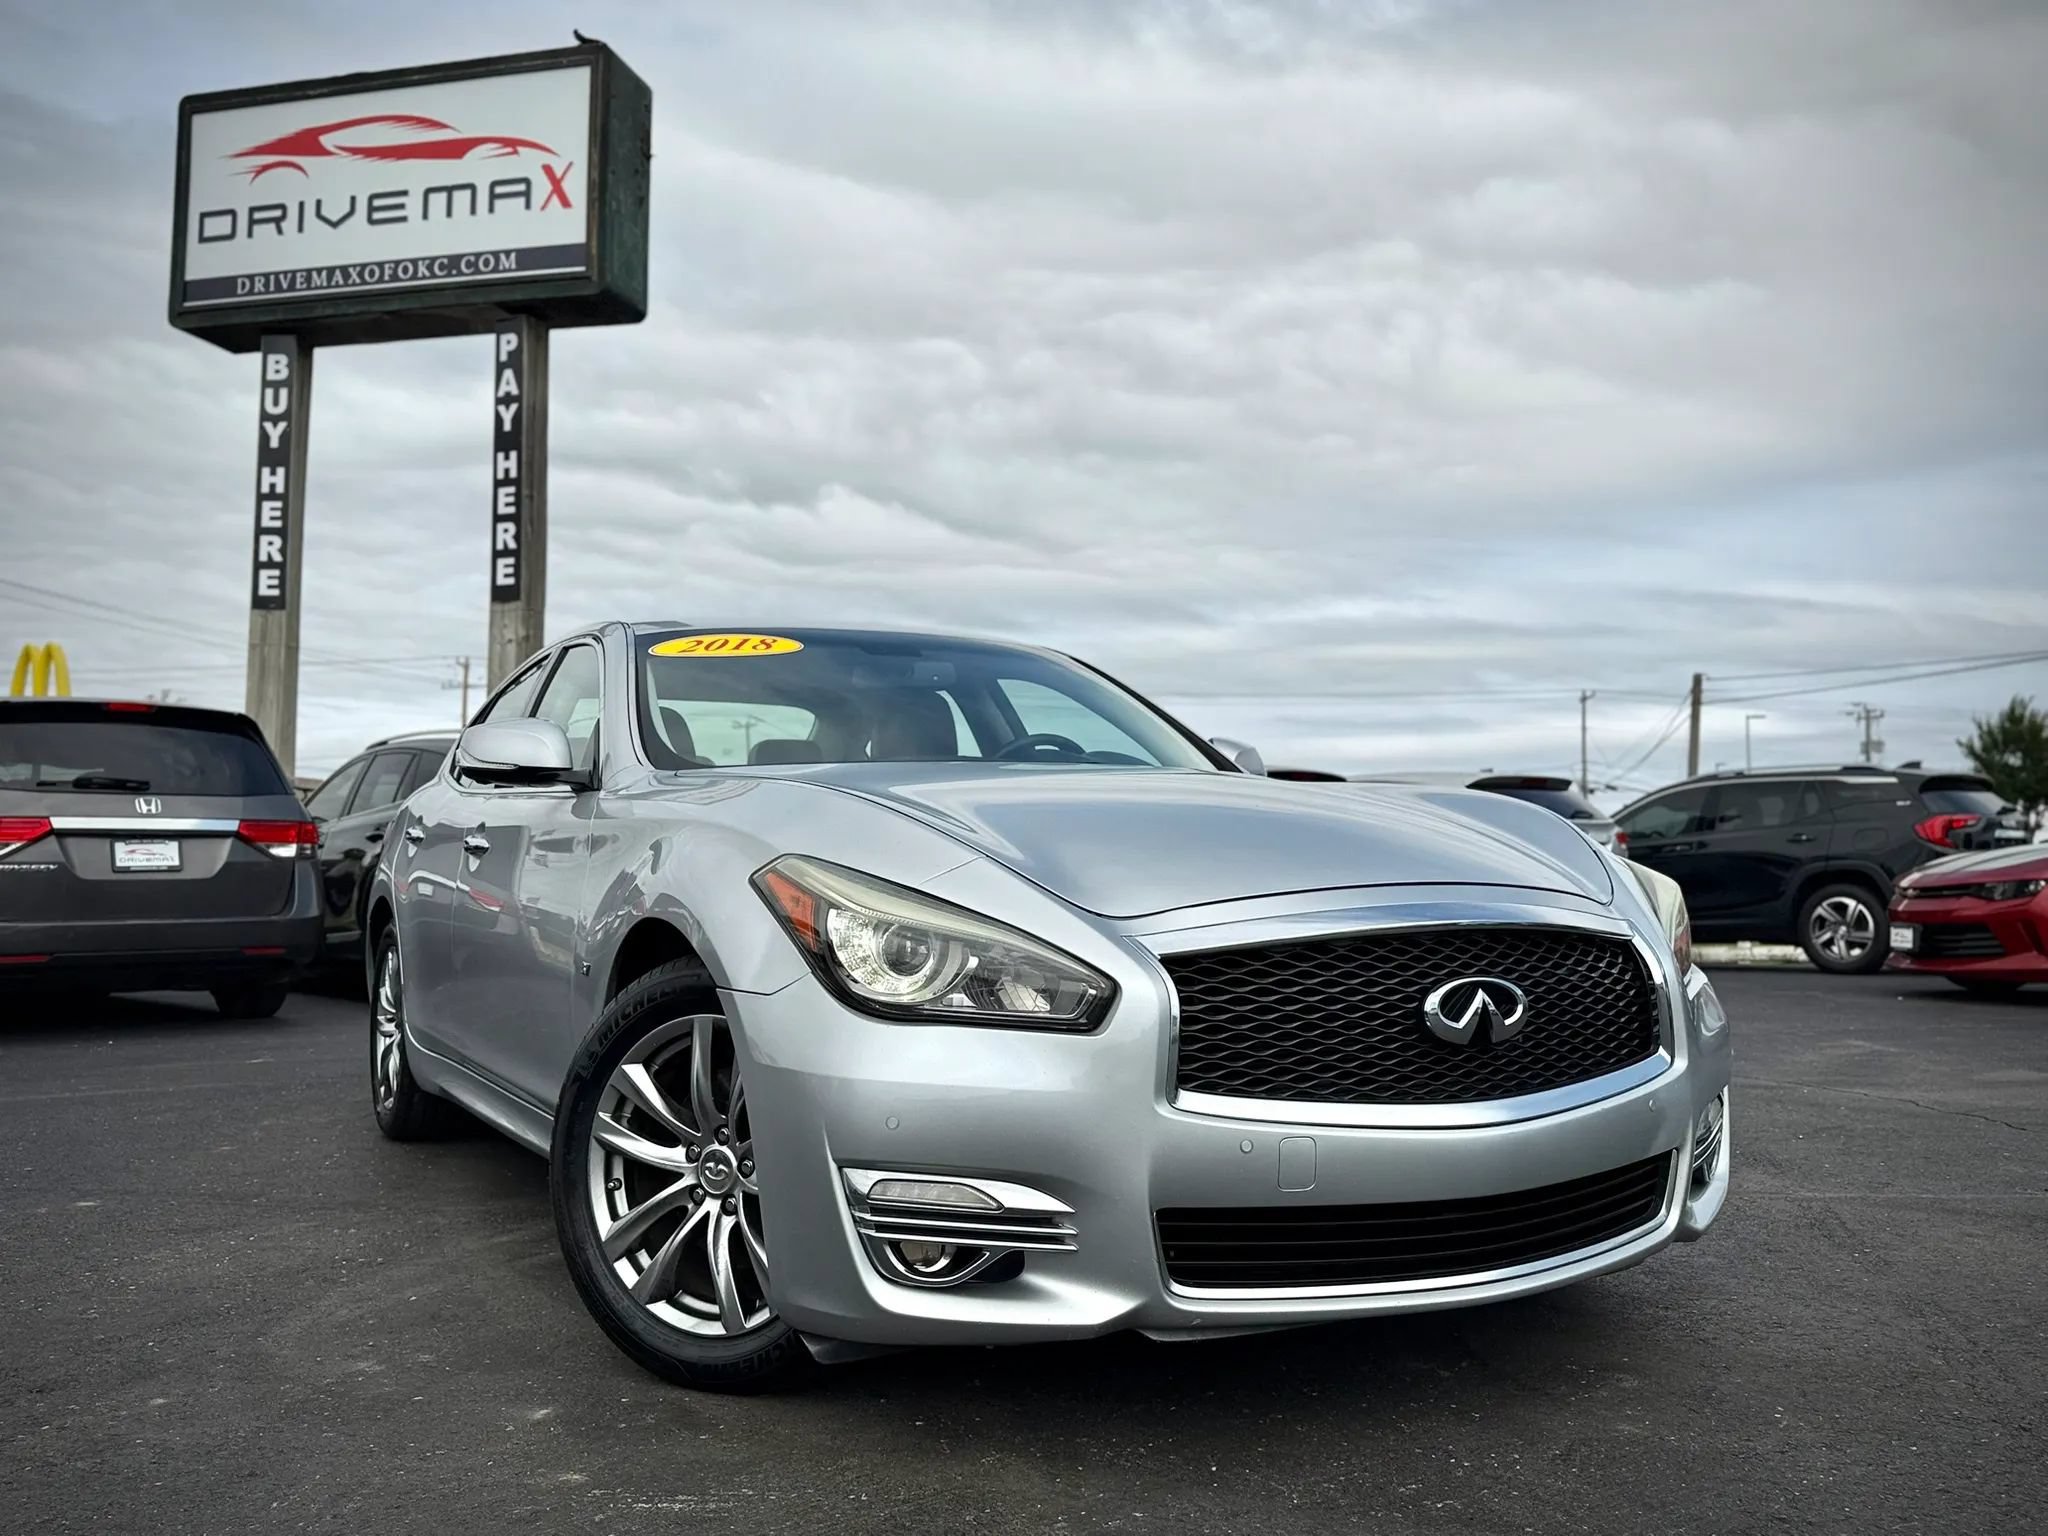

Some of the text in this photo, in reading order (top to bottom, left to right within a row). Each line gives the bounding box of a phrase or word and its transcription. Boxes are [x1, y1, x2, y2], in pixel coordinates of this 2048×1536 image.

[198, 161, 574, 244] DRIVEMAX
[236, 251, 518, 295] DRIVEMAXOFOKC.COM
[257, 353, 290, 597] BUY HERE
[495, 332, 519, 587] PAY HERE
[678, 638, 777, 653] 2018
